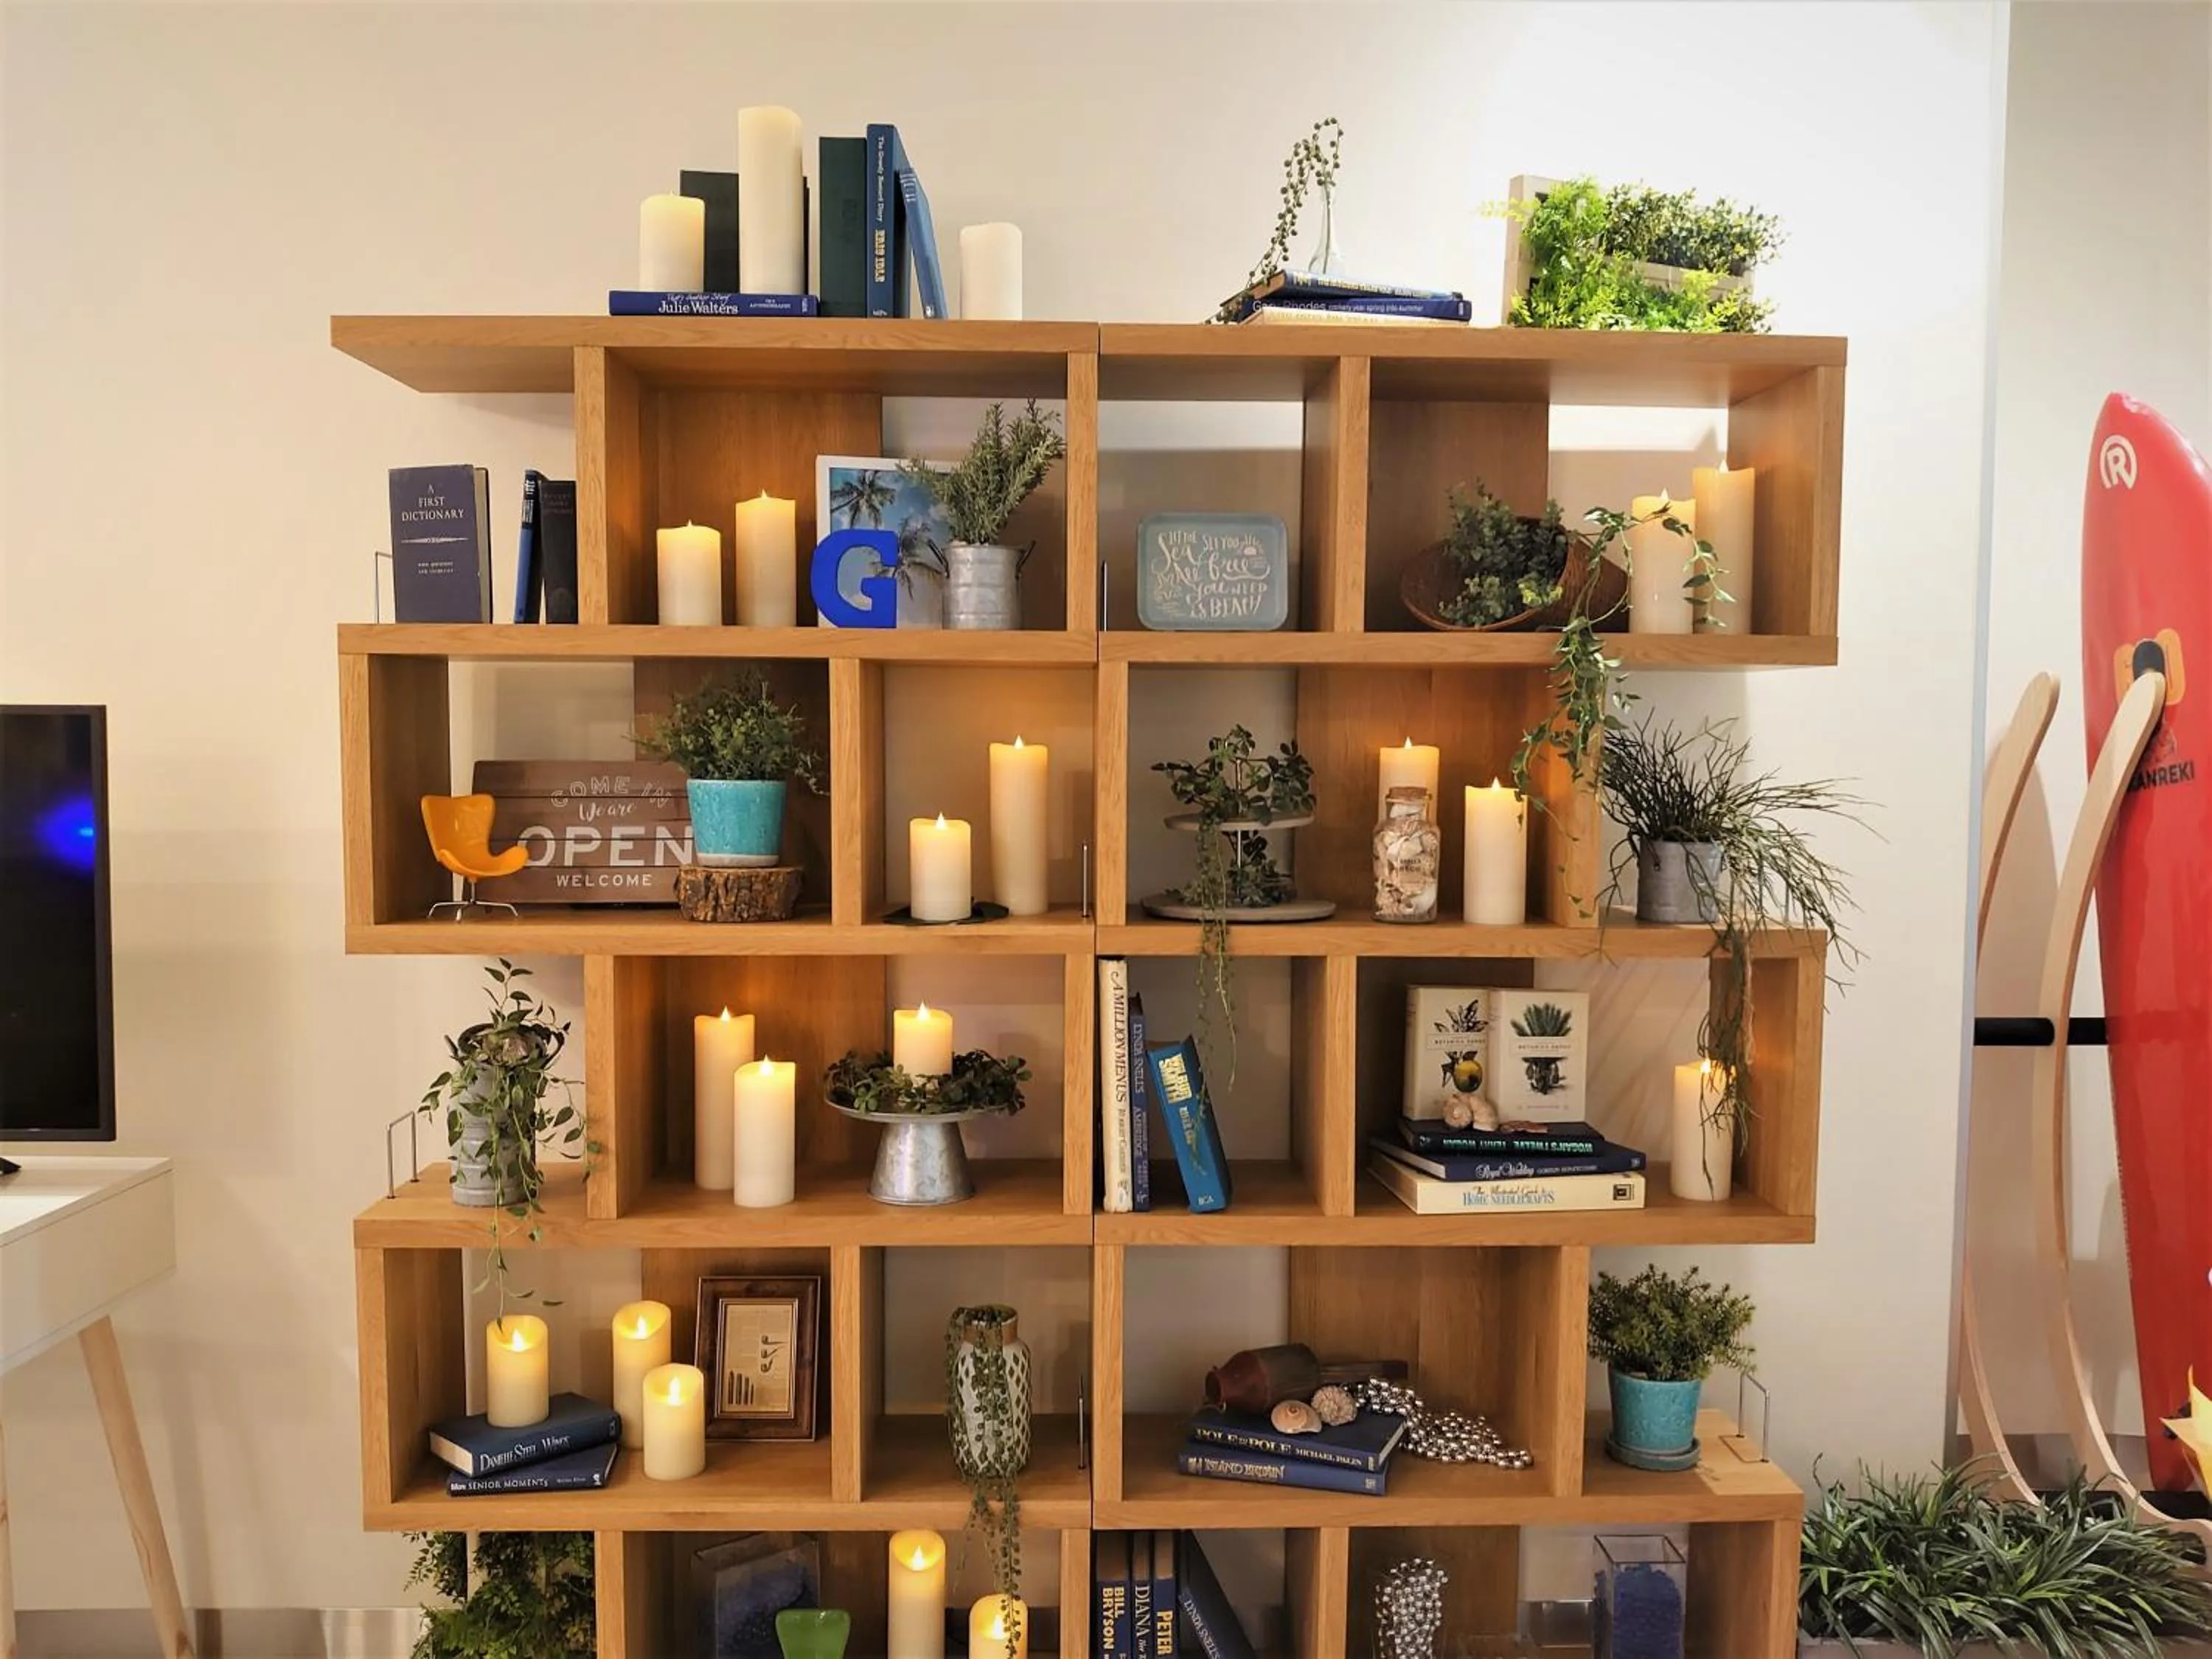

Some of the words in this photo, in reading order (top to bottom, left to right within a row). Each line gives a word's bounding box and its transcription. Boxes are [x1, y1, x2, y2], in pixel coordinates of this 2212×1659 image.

[658, 300, 690, 313] Julie
[690, 301, 739, 315] Walters
[418, 496, 445, 507] FIRST
[428, 483, 434, 494] A
[402, 509, 464, 521] DICTIONARY
[810, 529, 899, 628] G
[551, 776, 631, 807] COME
[518, 826, 695, 867] OPEN
[557, 874, 653, 888] WELCOME
[1113, 994, 1126, 1048] MILLION
[1115, 1051, 1127, 1103] MENUS
[1295, 1447, 1335, 1461] MICHAEL
[468, 1479, 502, 1490] SENIOR
[504, 1478, 549, 1488] MOMENTS
[1102, 1587, 1114, 1650] BRYSON
[1114, 1586, 1125, 1619] BILL
[1135, 1585, 1151, 1637] DIANA
[1156, 1610, 1173, 1656] PETER
